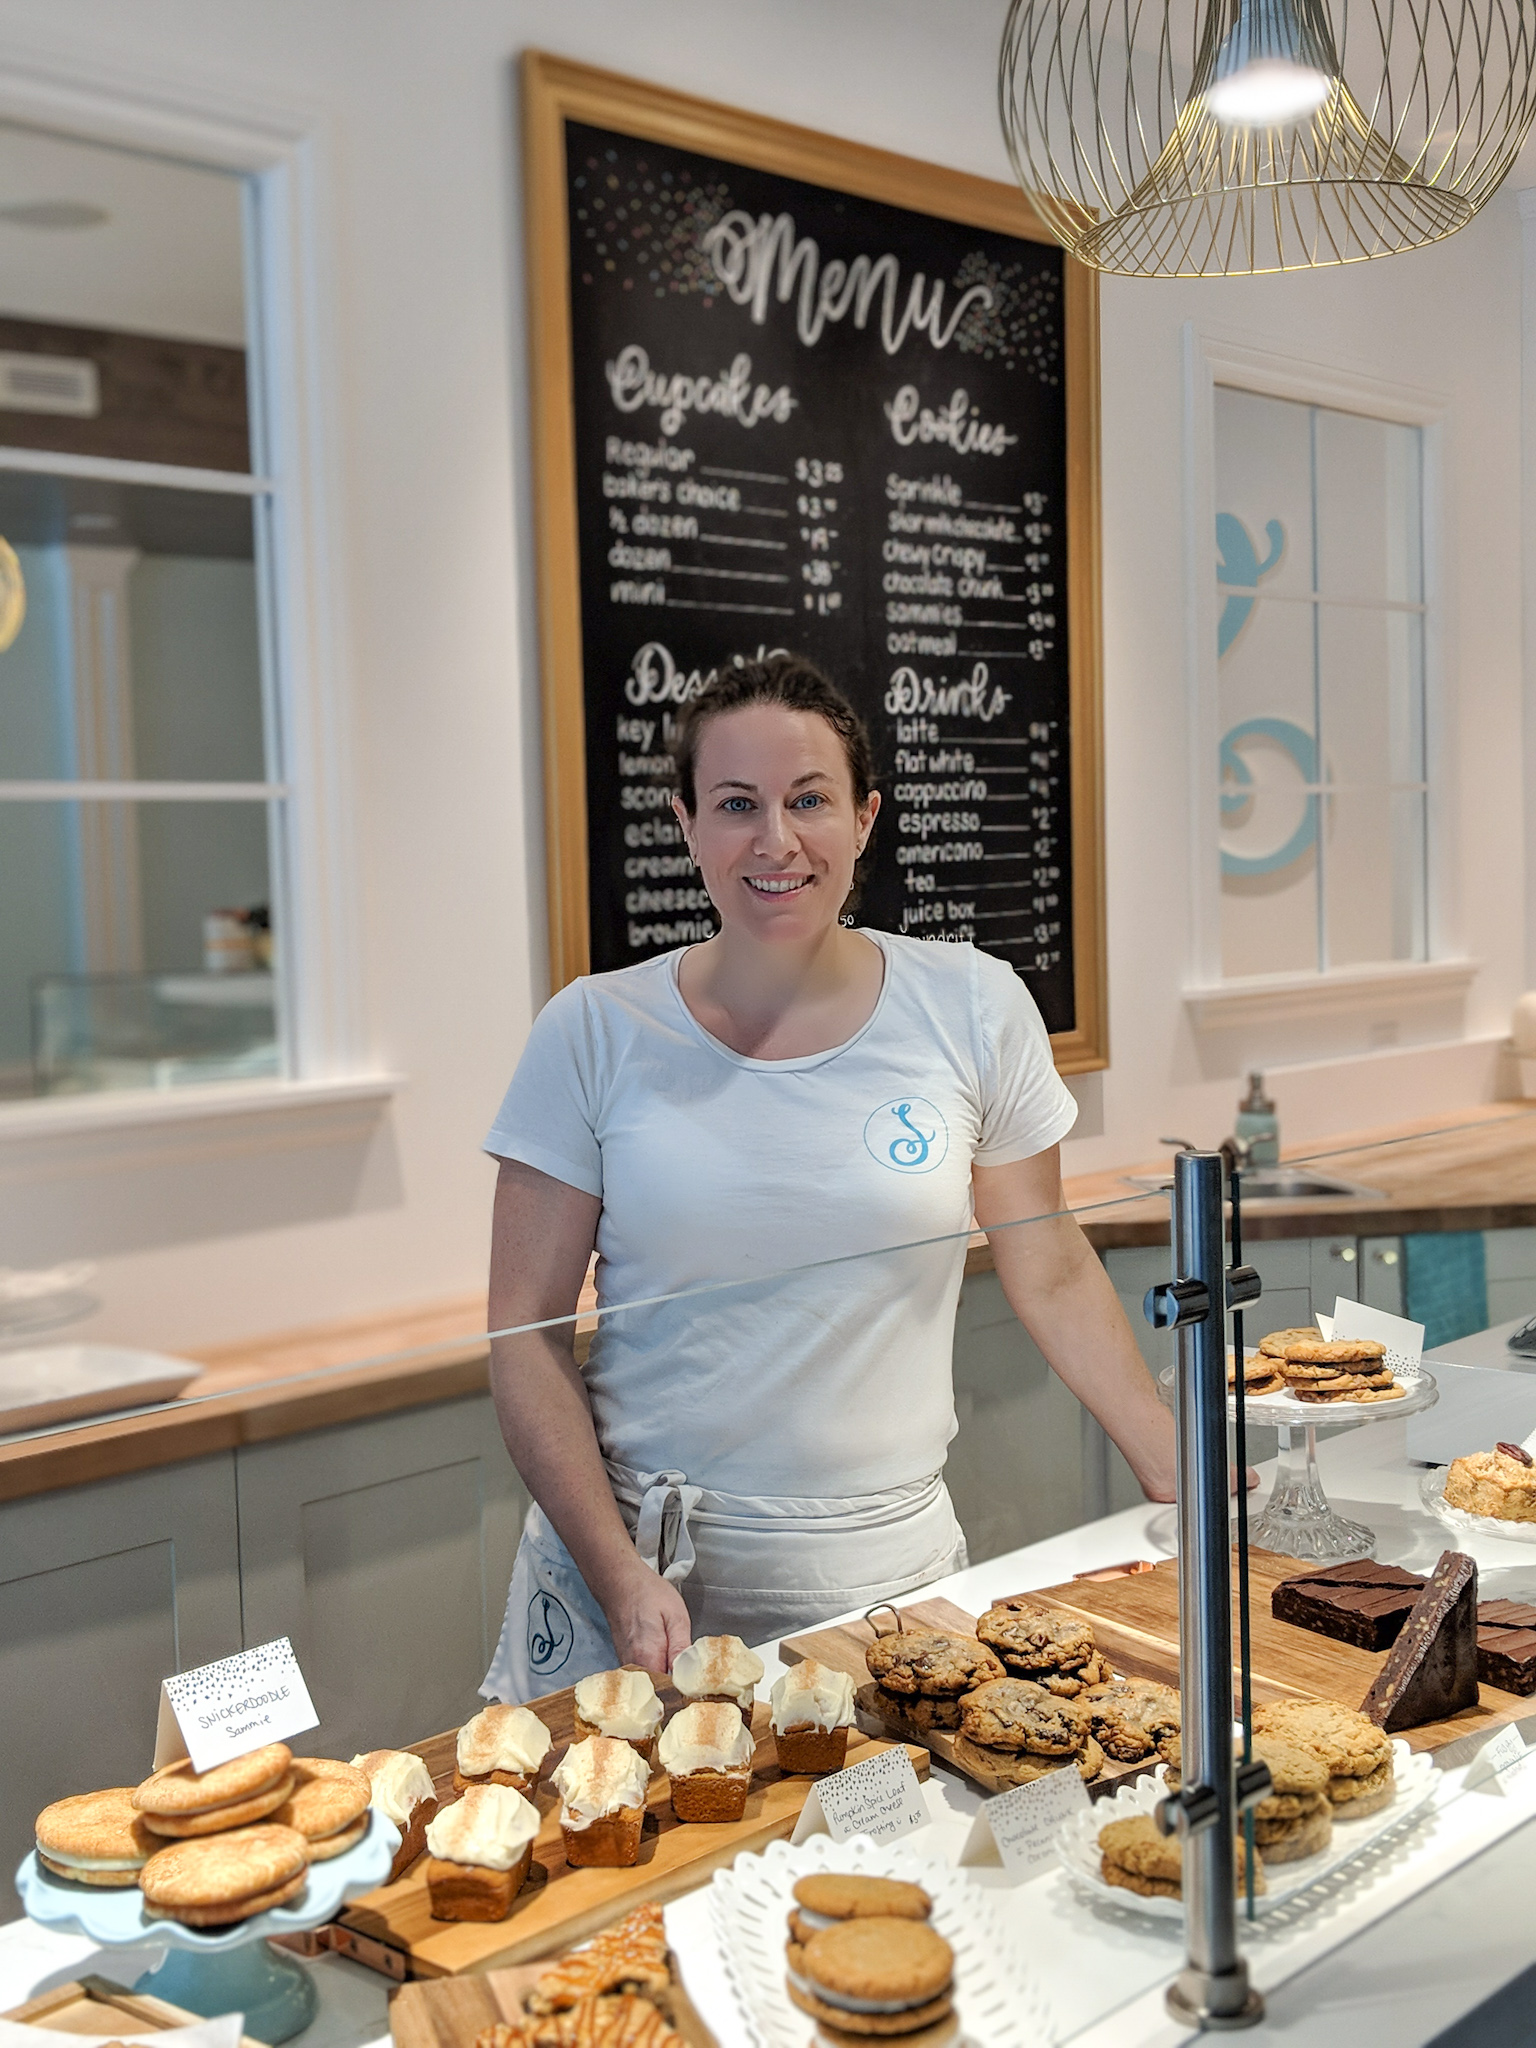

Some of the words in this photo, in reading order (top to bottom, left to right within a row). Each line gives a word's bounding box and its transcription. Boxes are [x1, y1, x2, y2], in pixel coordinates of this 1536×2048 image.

[704, 210, 994, 354] Menu
[606, 344, 798, 436] Cupcakes
[884, 385, 1019, 456] Cookies
[605, 434, 696, 480] Regular
[676, 476, 743, 513] choice
[631, 503, 699, 540] dozen
[607, 538, 672, 572] dozen
[609, 577, 666, 606] mini
[884, 661, 1014, 723] Drinks
[616, 712, 656, 753] key
[896, 717, 940, 745] latte
[617, 751, 677, 778] lemon
[895, 749, 927, 775] flat
[929, 748, 976, 775] white
[894, 777, 988, 809] cappuccino
[623, 816, 688, 849] eclai
[898, 807, 981, 842] espresso
[623, 855, 697, 880] cream
[895, 839, 985, 866] americano
[904, 866, 936, 894] tea
[899, 898, 945, 934] juice
[947, 899, 976, 921] box
[225, 1713, 272, 1738] Sammie
[832, 1802, 866, 1826] Pumpkin
[885, 1781, 907, 1799] Loaf
